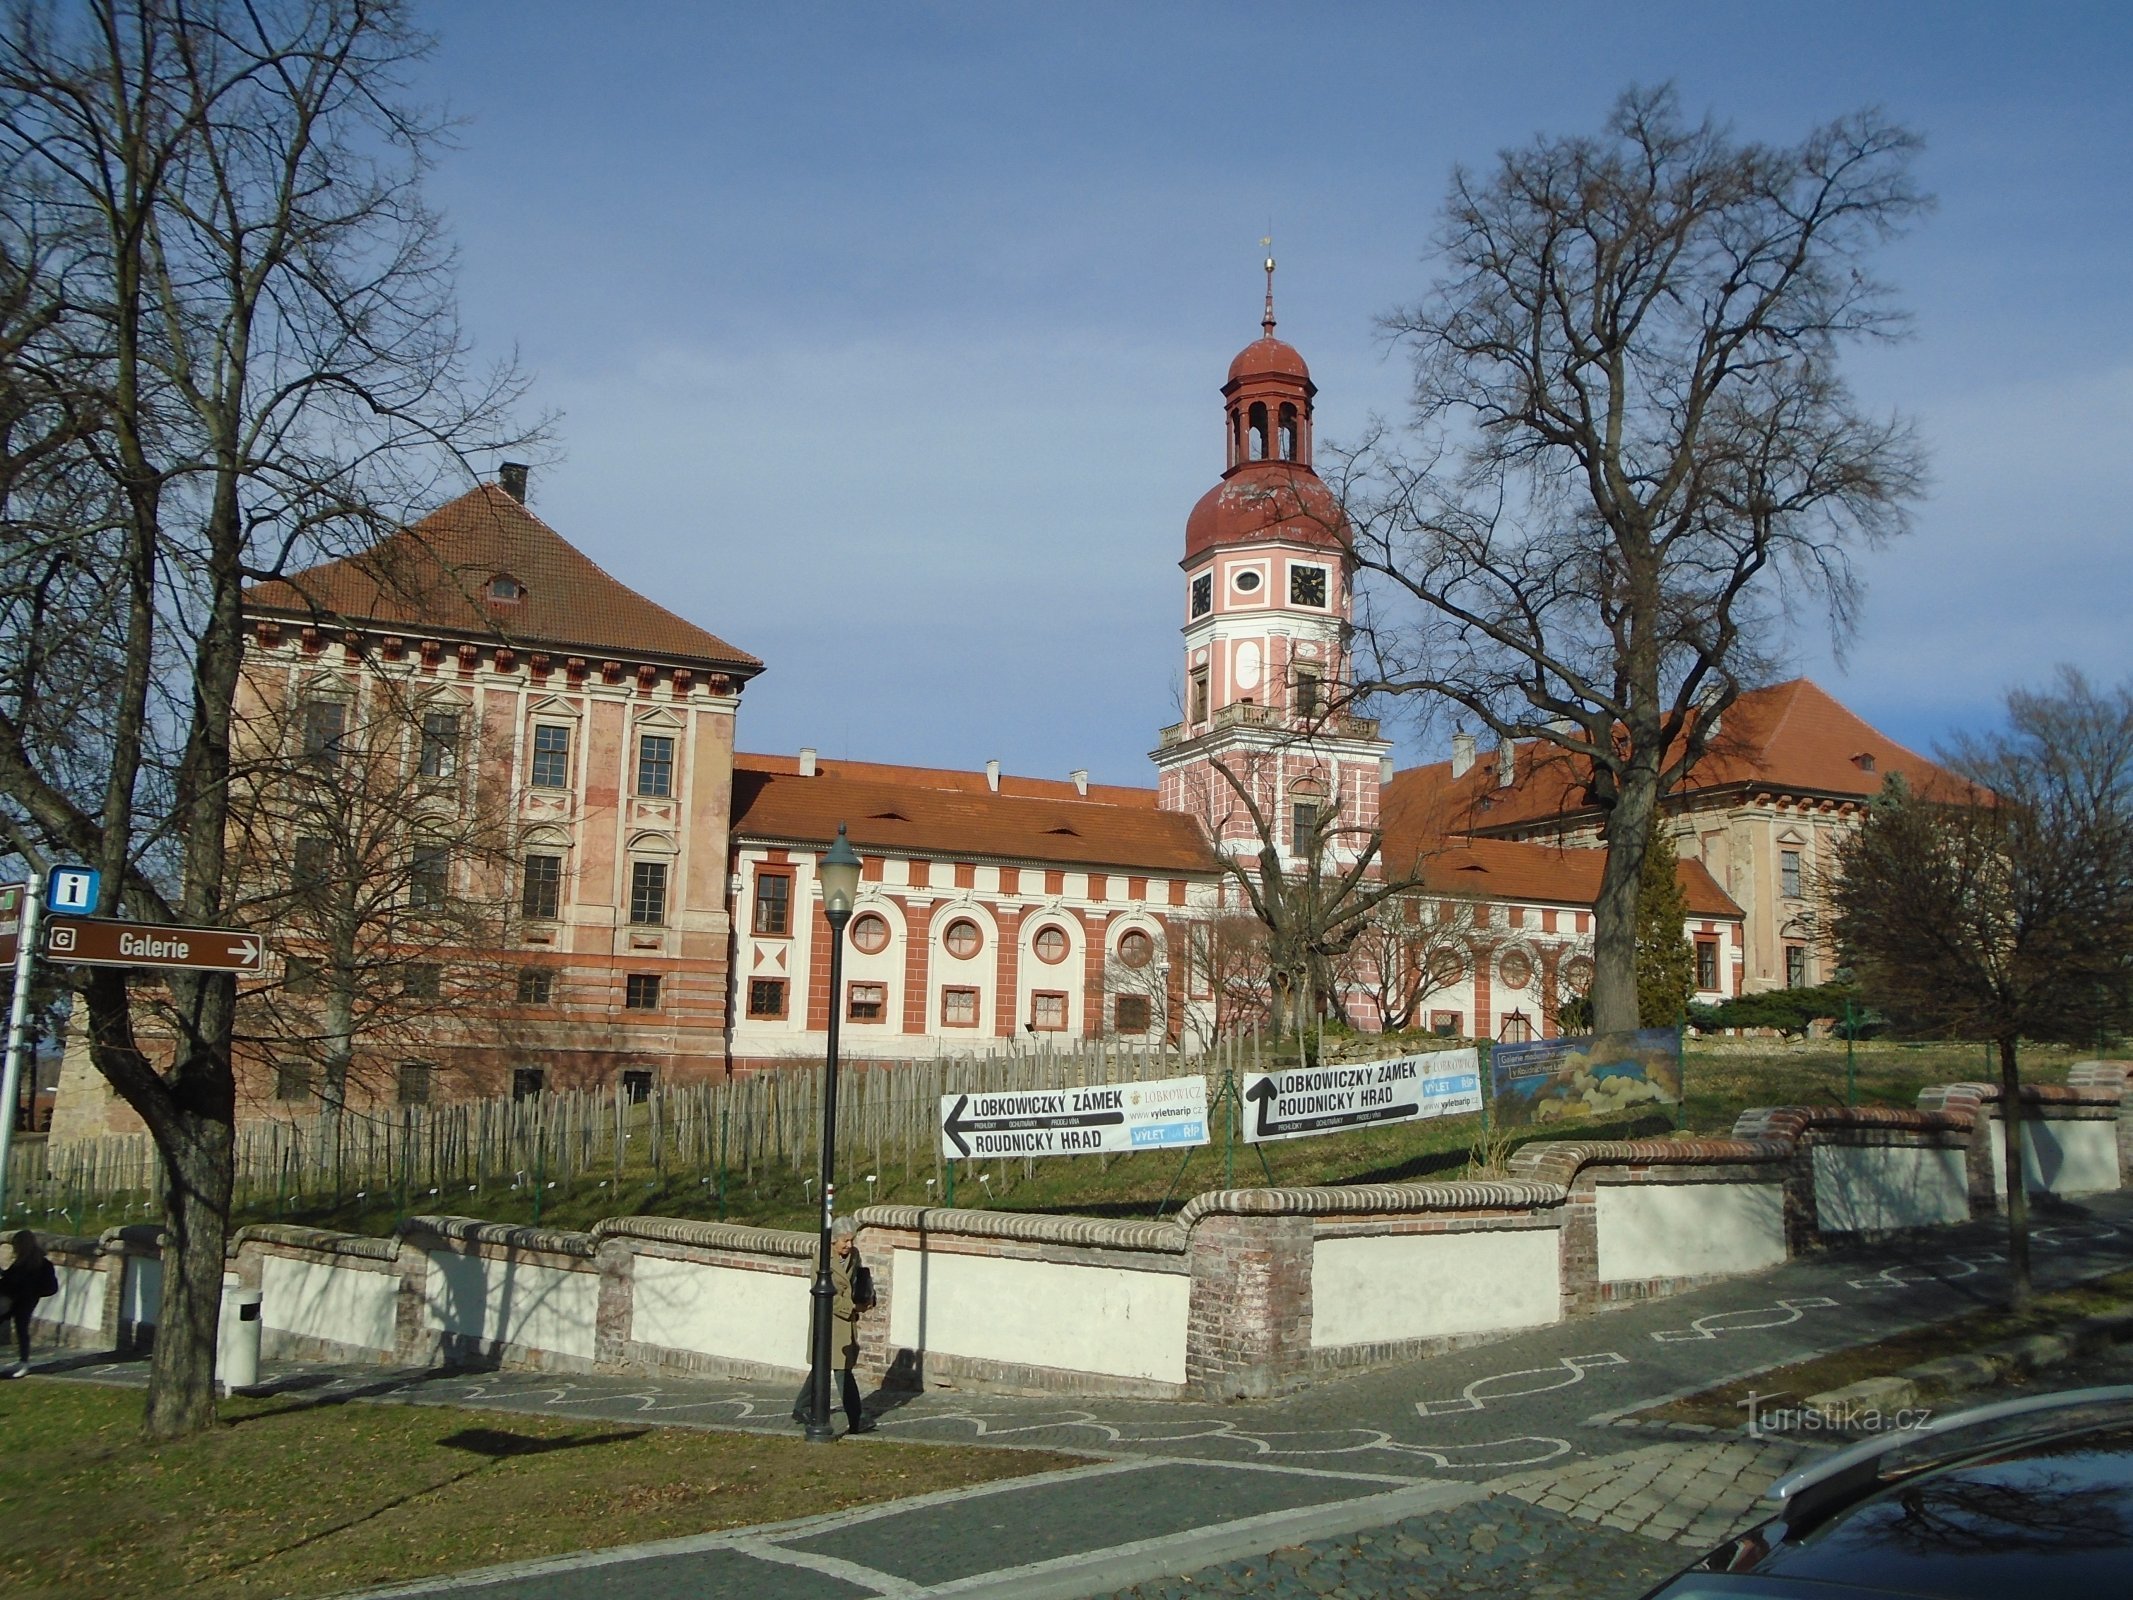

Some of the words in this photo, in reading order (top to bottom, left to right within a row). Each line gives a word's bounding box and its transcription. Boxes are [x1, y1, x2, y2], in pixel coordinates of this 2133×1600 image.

[56, 933, 71, 946] G
[119, 932, 190, 960] Galerie
[1279, 1064, 1373, 1094] LOBKOWICZKÝ
[1378, 1060, 1417, 1084] ZÁMEK
[973, 1090, 1067, 1117] LOBKOWICZKÝ
[1072, 1088, 1124, 1112] ZÁMEK
[1145, 1086, 1201, 1104] LOBKOWICZ
[1278, 1087, 1355, 1117] ROUDNICKÝ
[1361, 1086, 1393, 1107] HRAD
[1060, 1130, 1102, 1150] HRAD
[1134, 1128, 1166, 1142] VÝLET
[1183, 1124, 1200, 1138] ŘÍP
